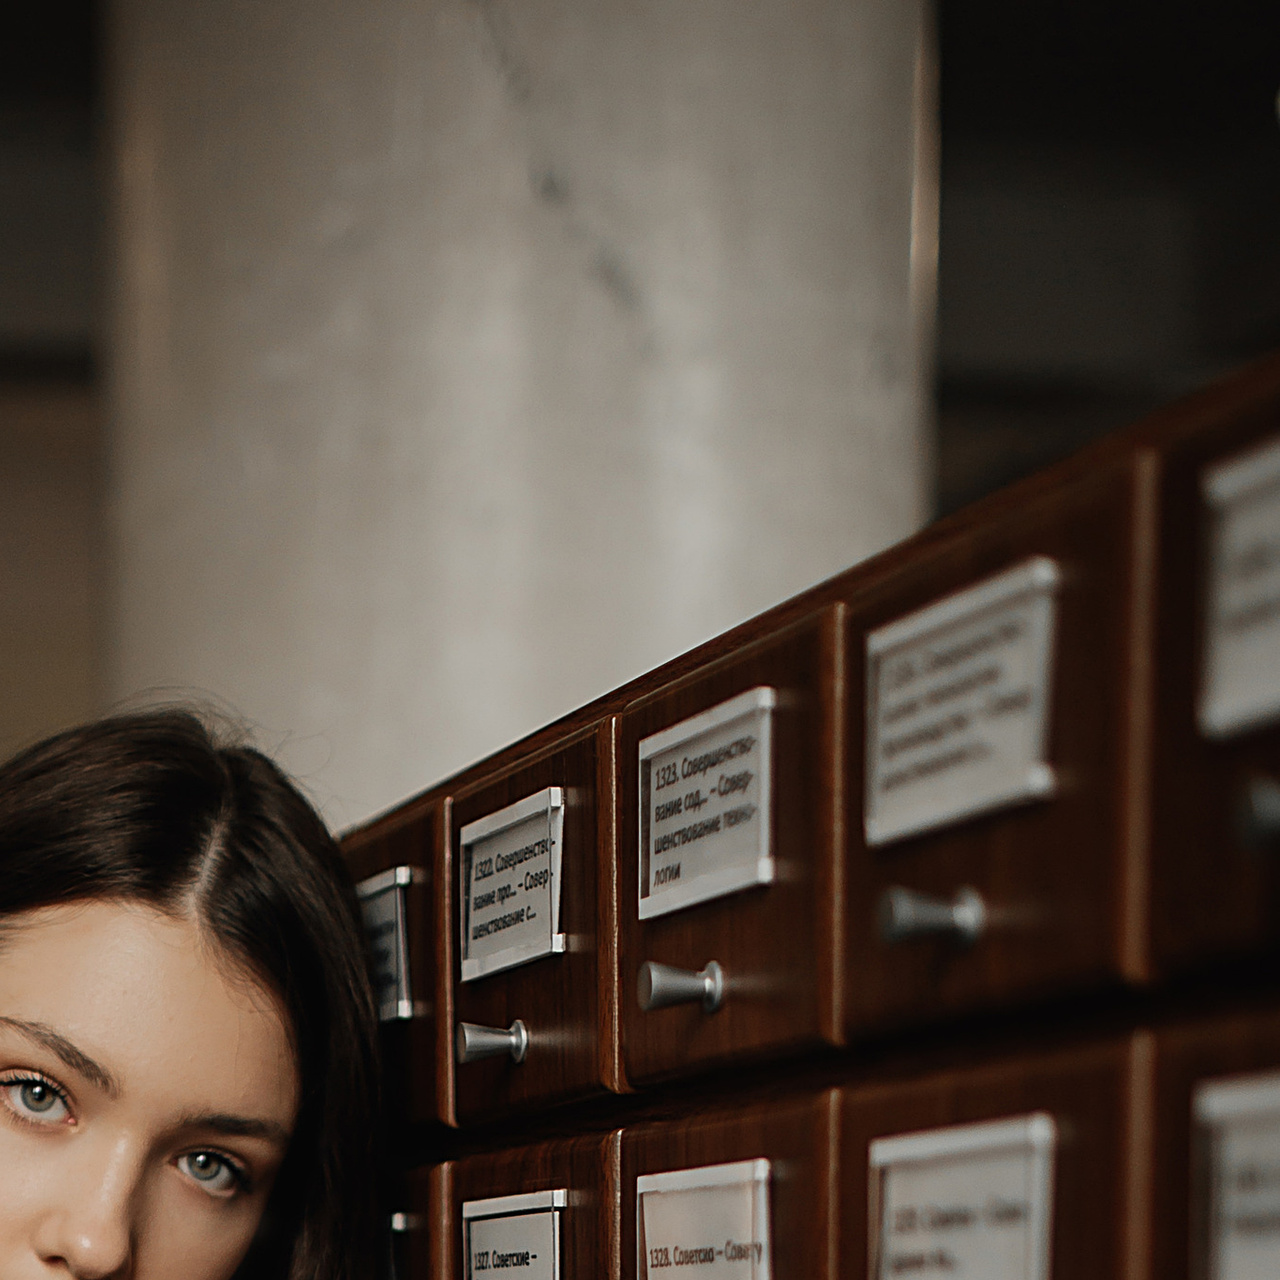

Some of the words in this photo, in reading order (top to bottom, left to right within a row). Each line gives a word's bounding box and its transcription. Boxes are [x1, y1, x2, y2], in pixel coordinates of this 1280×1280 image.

[655, 764, 680, 791] 1323.
[654, 796, 682, 823] вание
[653, 813, 721, 855] шенствование
[653, 861, 681, 888] логии
[492, 1250, 530, 1269] Советские
[649, 1247, 672, 1268] 1328.
[673, 1245, 715, 1267] Советско
